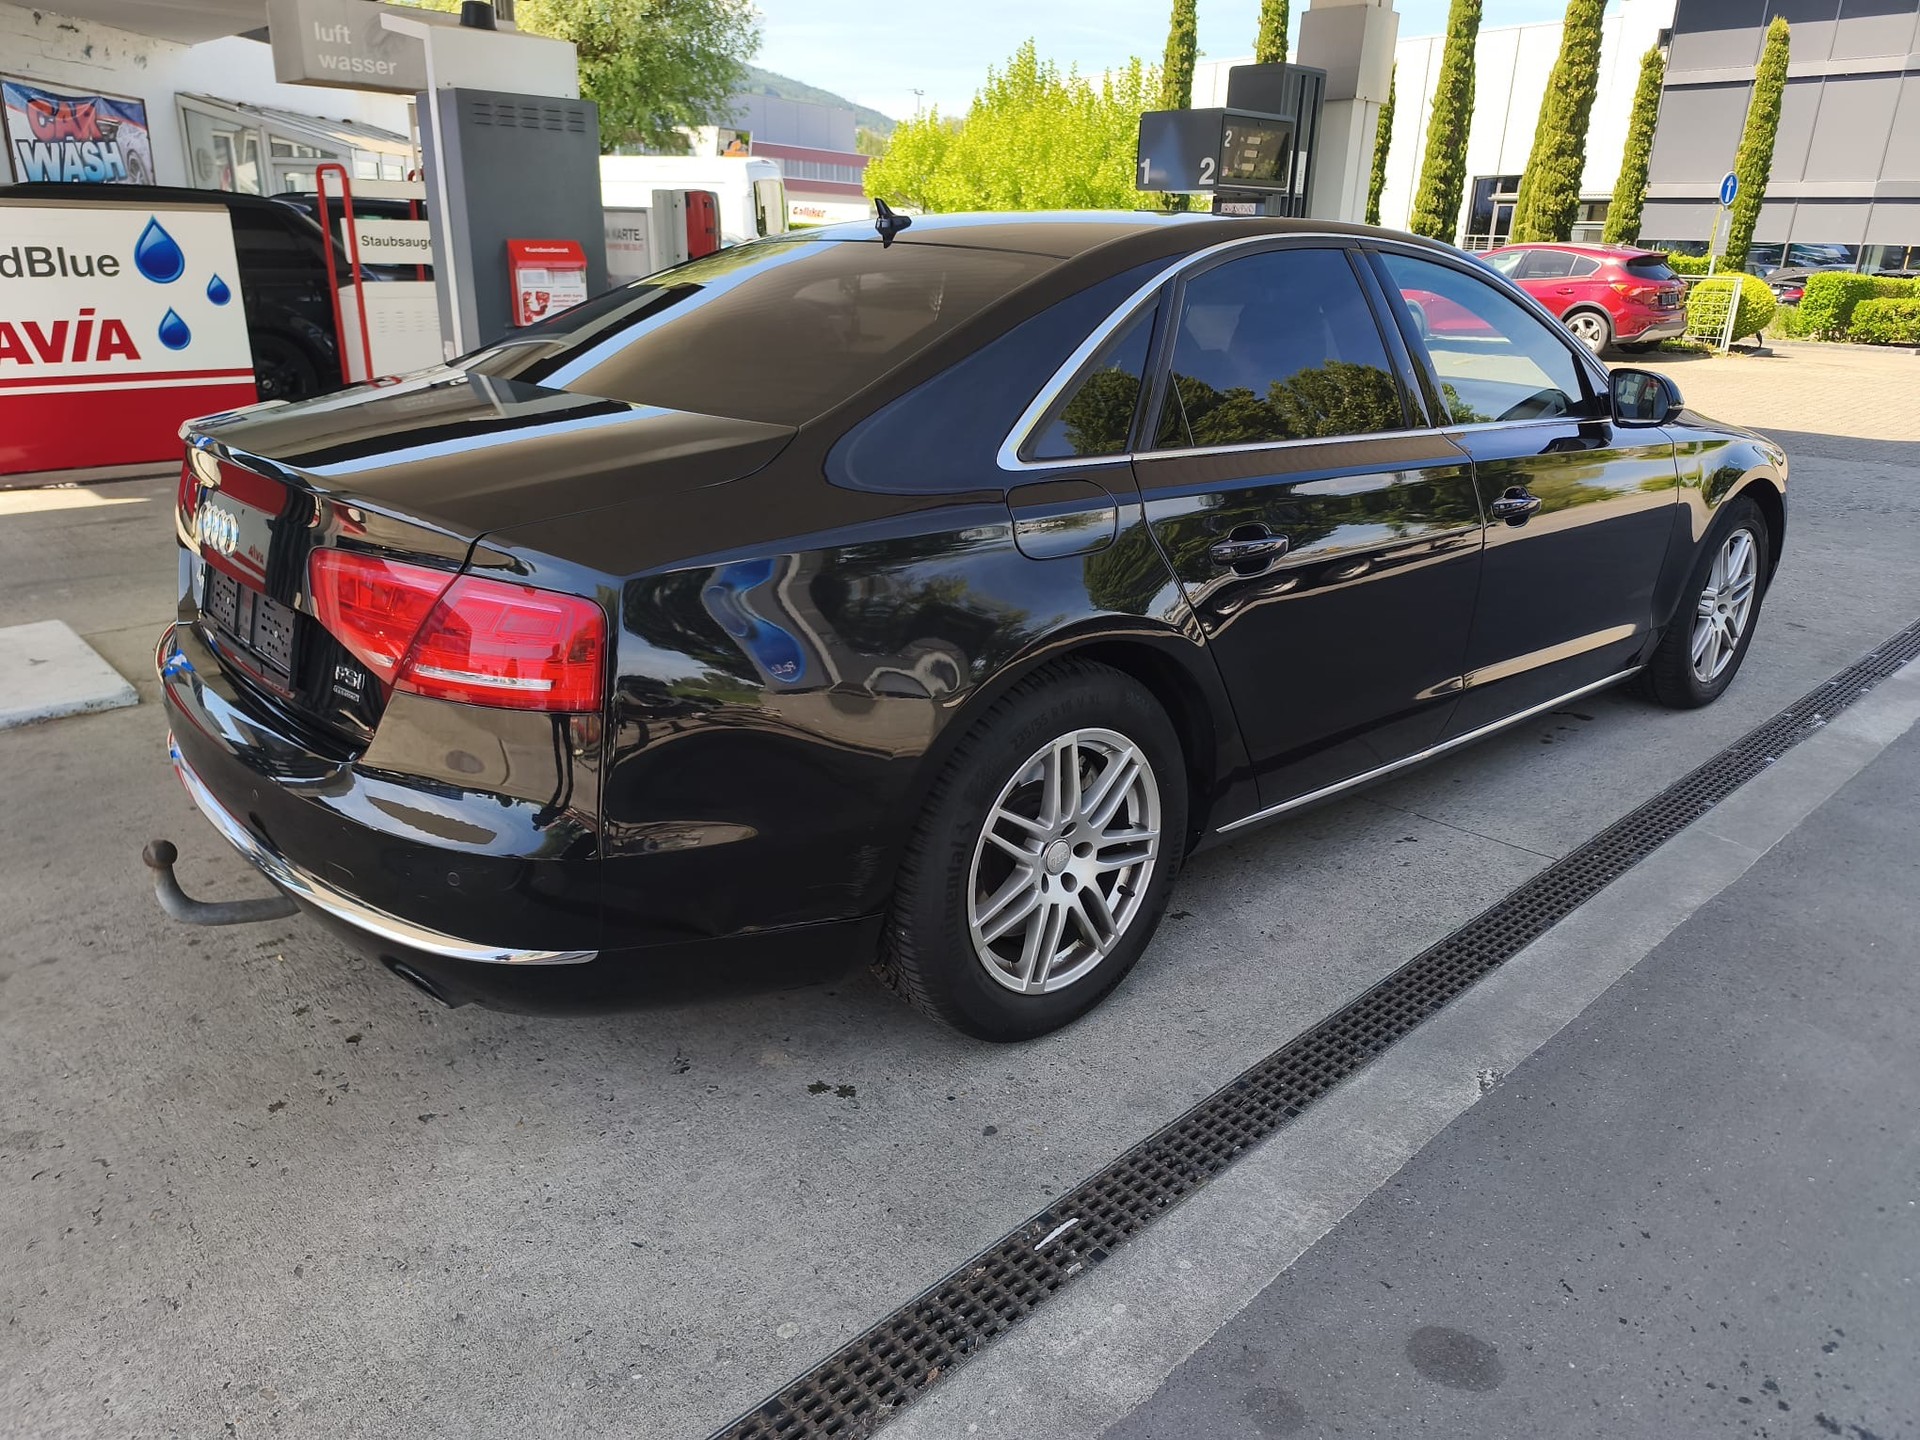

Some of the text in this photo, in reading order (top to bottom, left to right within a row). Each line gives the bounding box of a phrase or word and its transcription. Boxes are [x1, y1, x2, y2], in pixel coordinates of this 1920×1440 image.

[314, 21, 351, 45] luft
[318, 53, 397, 75] wasser
[27, 98, 103, 142] CAR
[1224, 130, 1233, 147] 2
[15, 139, 128, 182] WASH
[1140, 157, 1216, 185] 1 2
